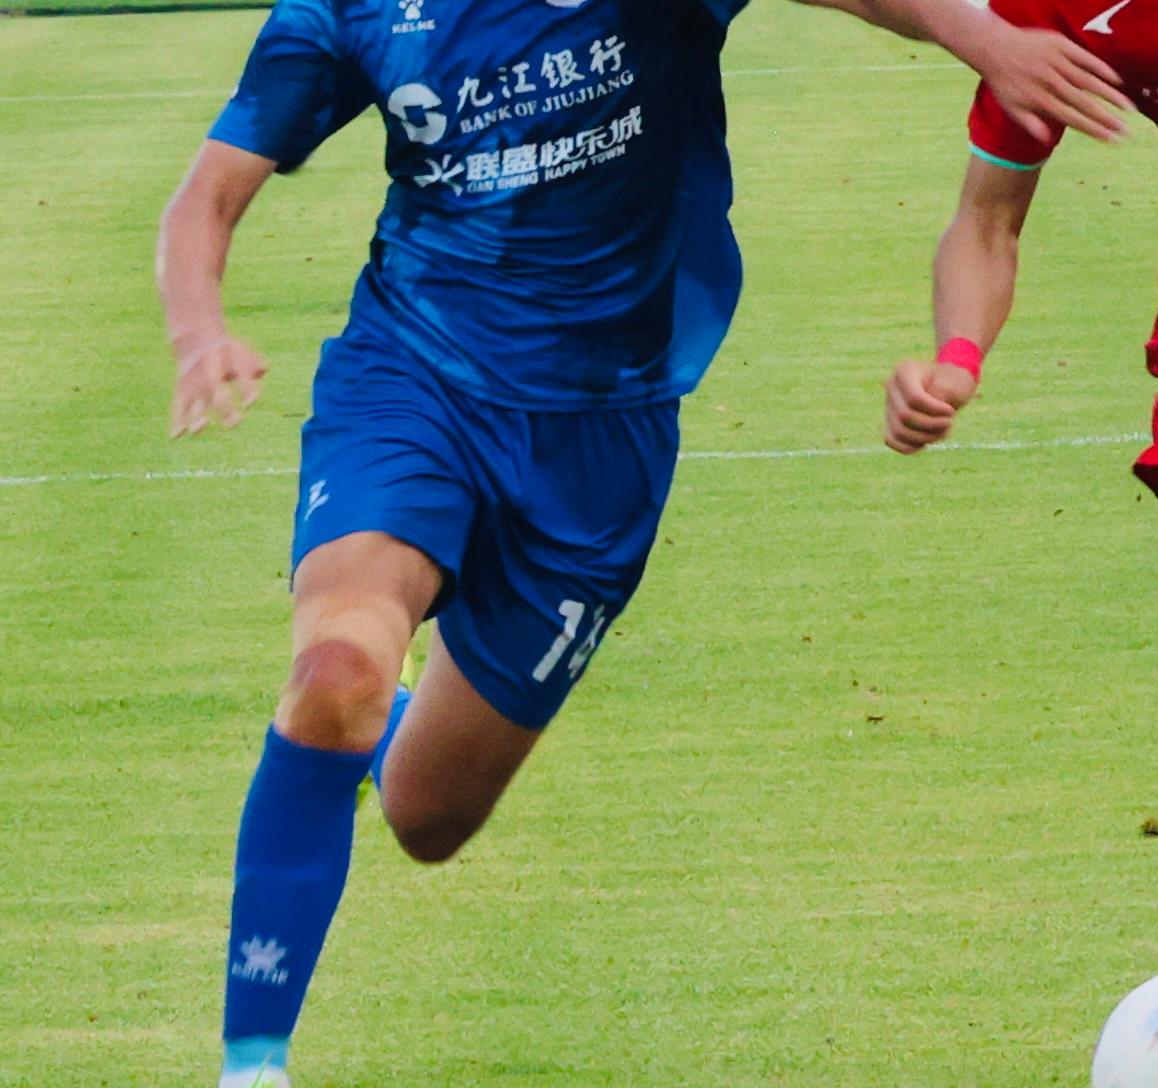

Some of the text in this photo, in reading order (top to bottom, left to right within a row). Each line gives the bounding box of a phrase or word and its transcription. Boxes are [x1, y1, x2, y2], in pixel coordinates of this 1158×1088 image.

[456, 34, 627, 113] 九江银行
[460, 69, 634, 134] BANK OF JIUJIANG
[466, 105, 644, 181] 联盛快乐城
[544, 159, 588, 182] HAPPY
[590, 143, 626, 165] TOWN
